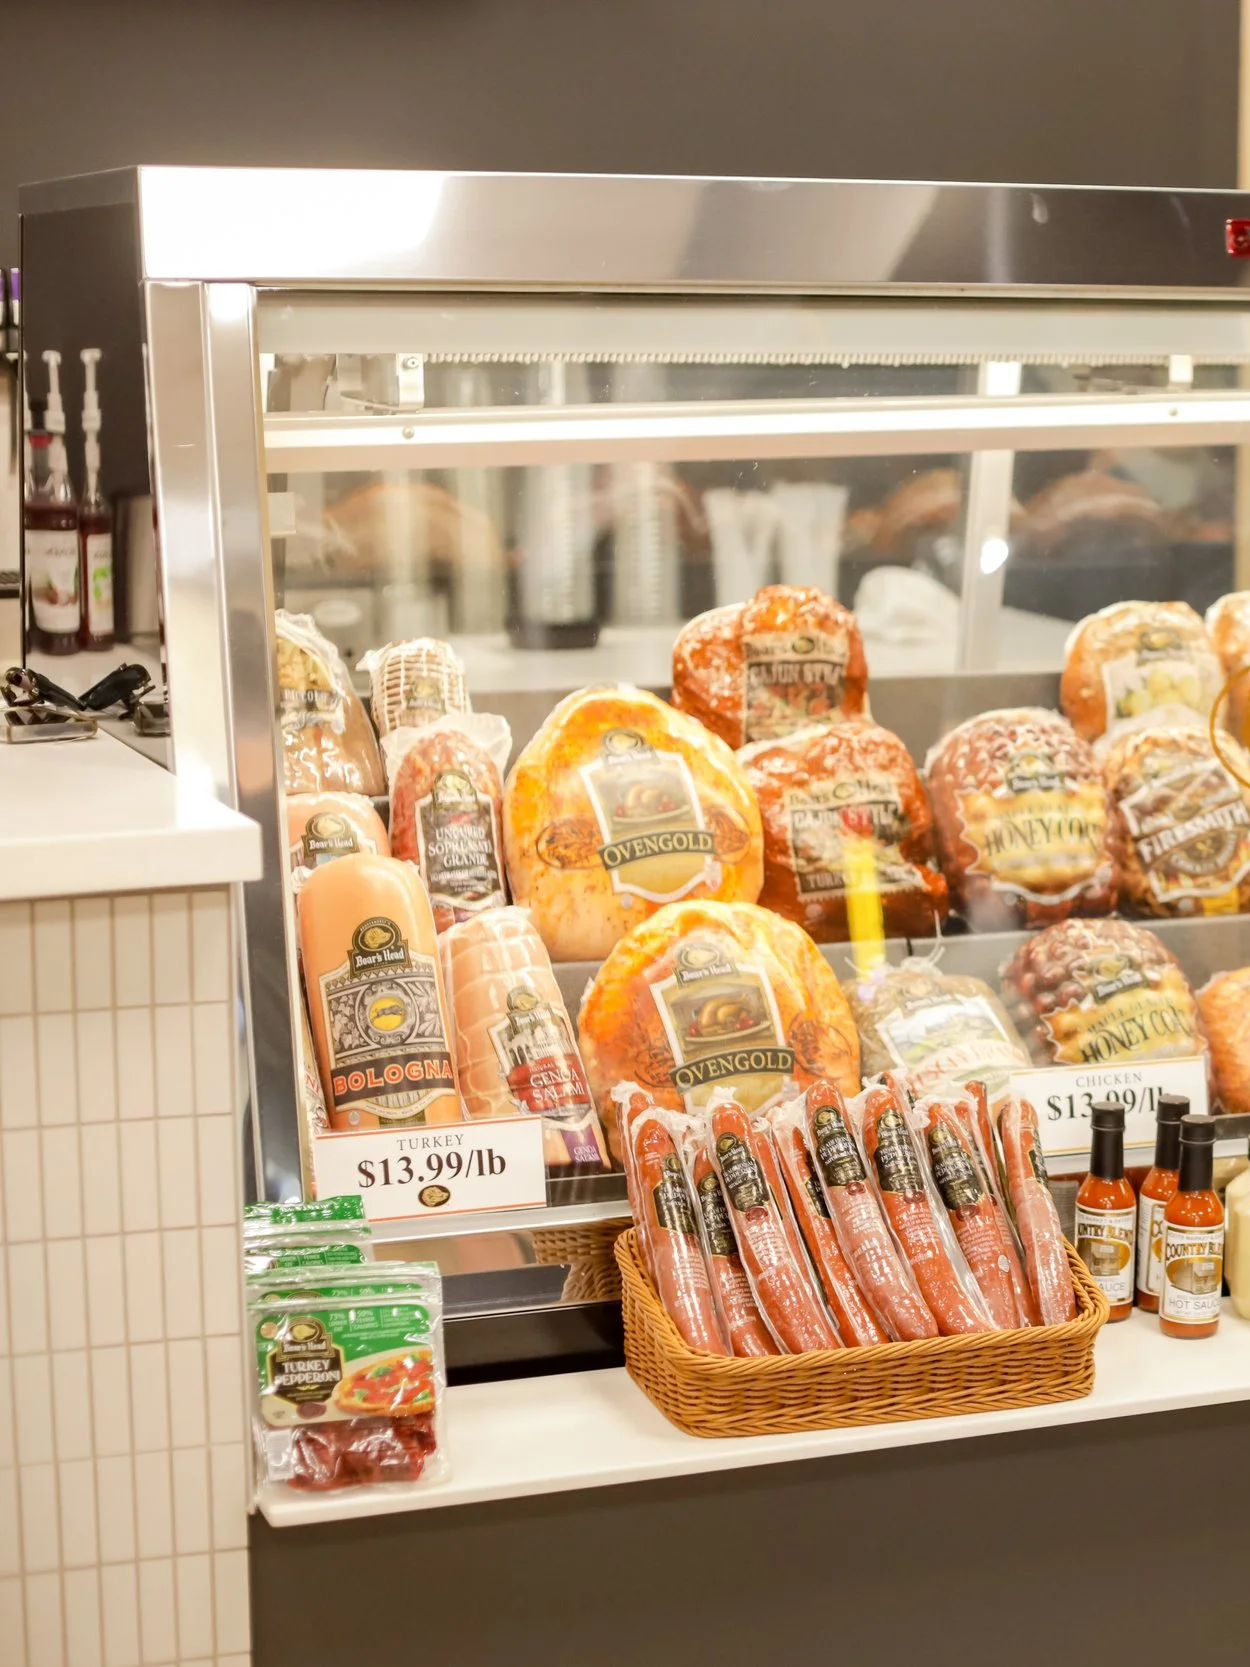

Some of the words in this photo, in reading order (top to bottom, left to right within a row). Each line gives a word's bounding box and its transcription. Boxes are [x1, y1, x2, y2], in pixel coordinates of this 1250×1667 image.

[984, 818, 1052, 857] HONEY
[1137, 800, 1250, 863] FIRESMITH
[309, 837, 334, 850] Boar's
[335, 836, 354, 848] Head
[604, 831, 713, 868] OVENGOLD
[355, 952, 383, 969] Boar's
[383, 947, 405, 962] Head
[708, 962, 733, 977] Head
[1080, 1014, 1150, 1063] HONEY
[333, 1059, 454, 1096] BOLOGNA
[529, 1067, 580, 1089] GENOA
[675, 1050, 792, 1090] OVENGOLD
[1075, 1072, 1142, 1088] CHICKEN
[531, 1082, 585, 1102] SALAMI
[1047, 1086, 1163, 1121] $1399/l
[396, 1134, 464, 1152] TURKEY
[356, 1148, 507, 1189] $13.99/lb
[1076, 1222, 1105, 1237] UNTRY
[1098, 1281, 1126, 1293] AUCE
[1168, 1299, 1190, 1310] HOT
[281, 1358, 331, 1374] TURKEY
[274, 1370, 341, 1387] PEPPERONI
